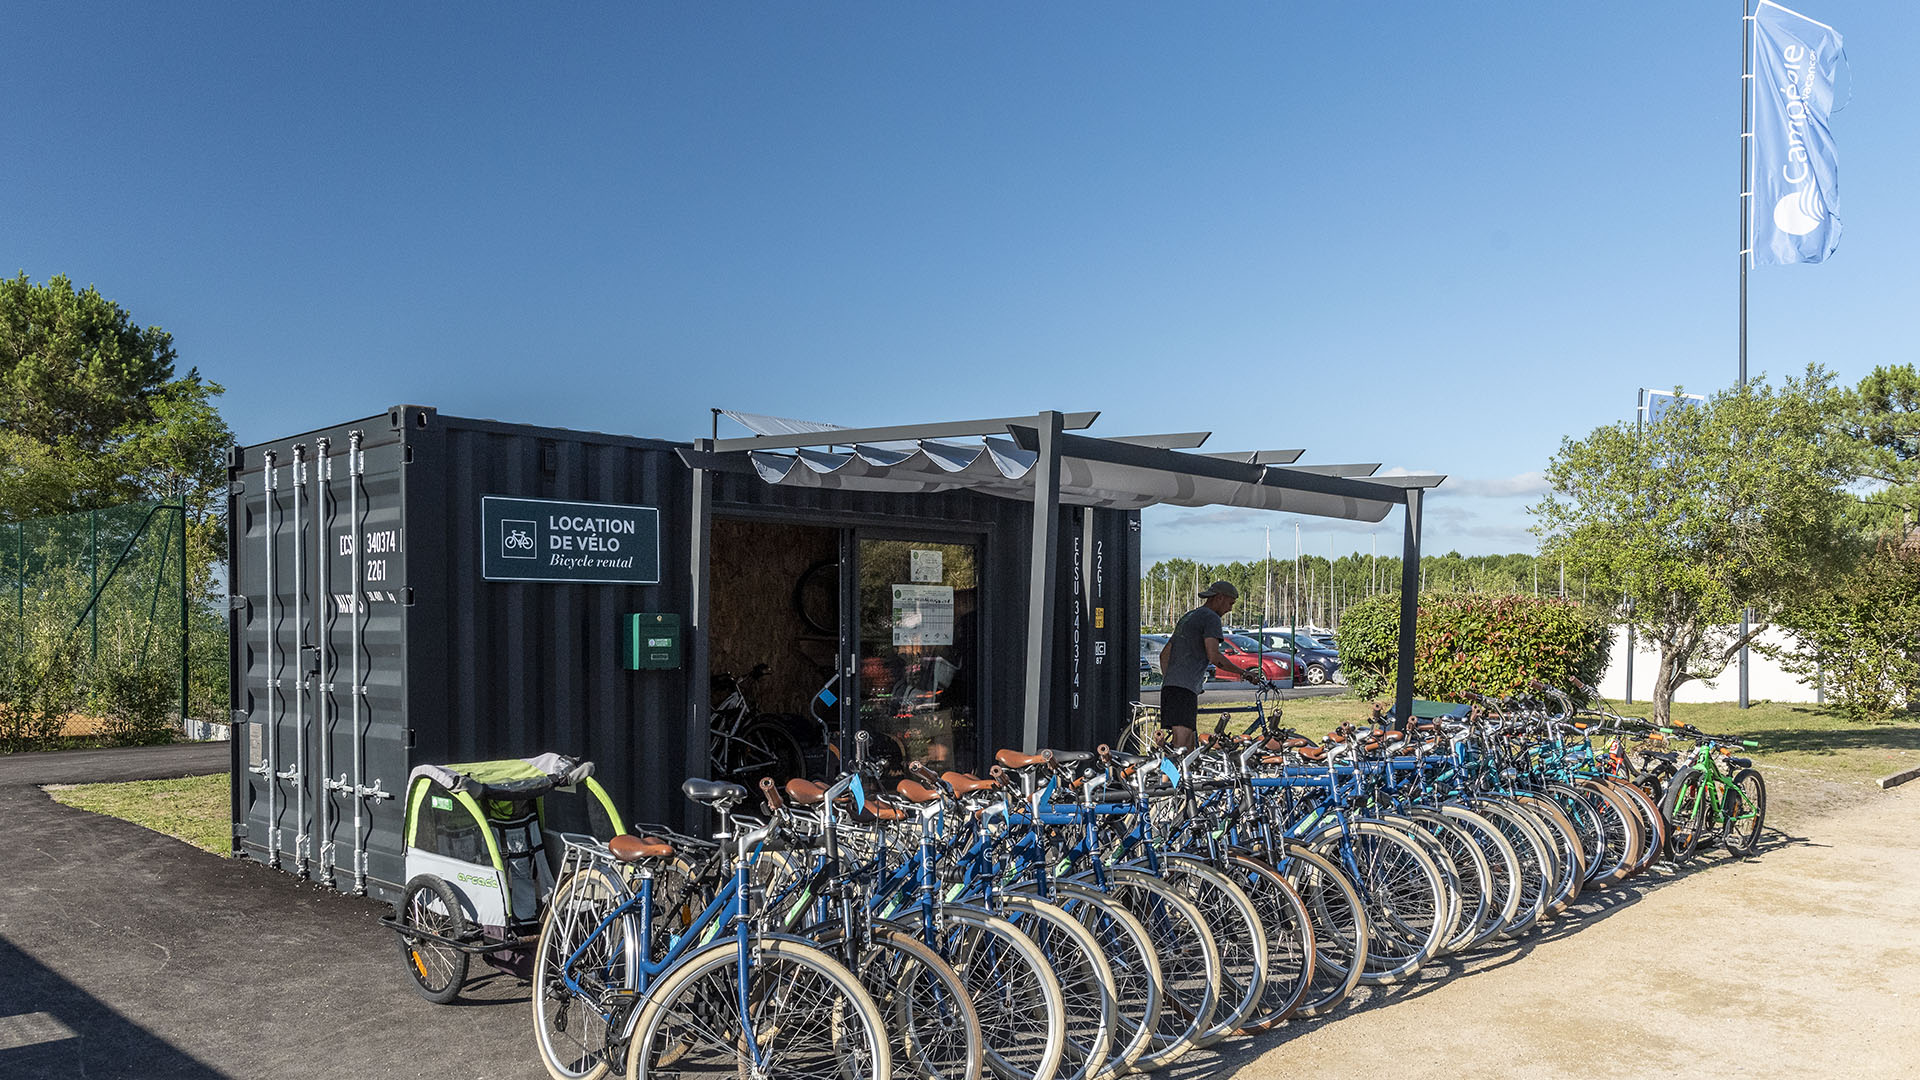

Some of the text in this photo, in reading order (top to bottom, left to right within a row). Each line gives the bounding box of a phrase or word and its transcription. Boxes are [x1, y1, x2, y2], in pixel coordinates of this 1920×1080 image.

[550, 515, 635, 534] LOCATION
[340, 531, 396, 556] ECS 340374
[550, 532, 620, 552] DE VÉLO
[367, 560, 386, 580] 22G1
[550, 554, 634, 569] Bicycle rental
